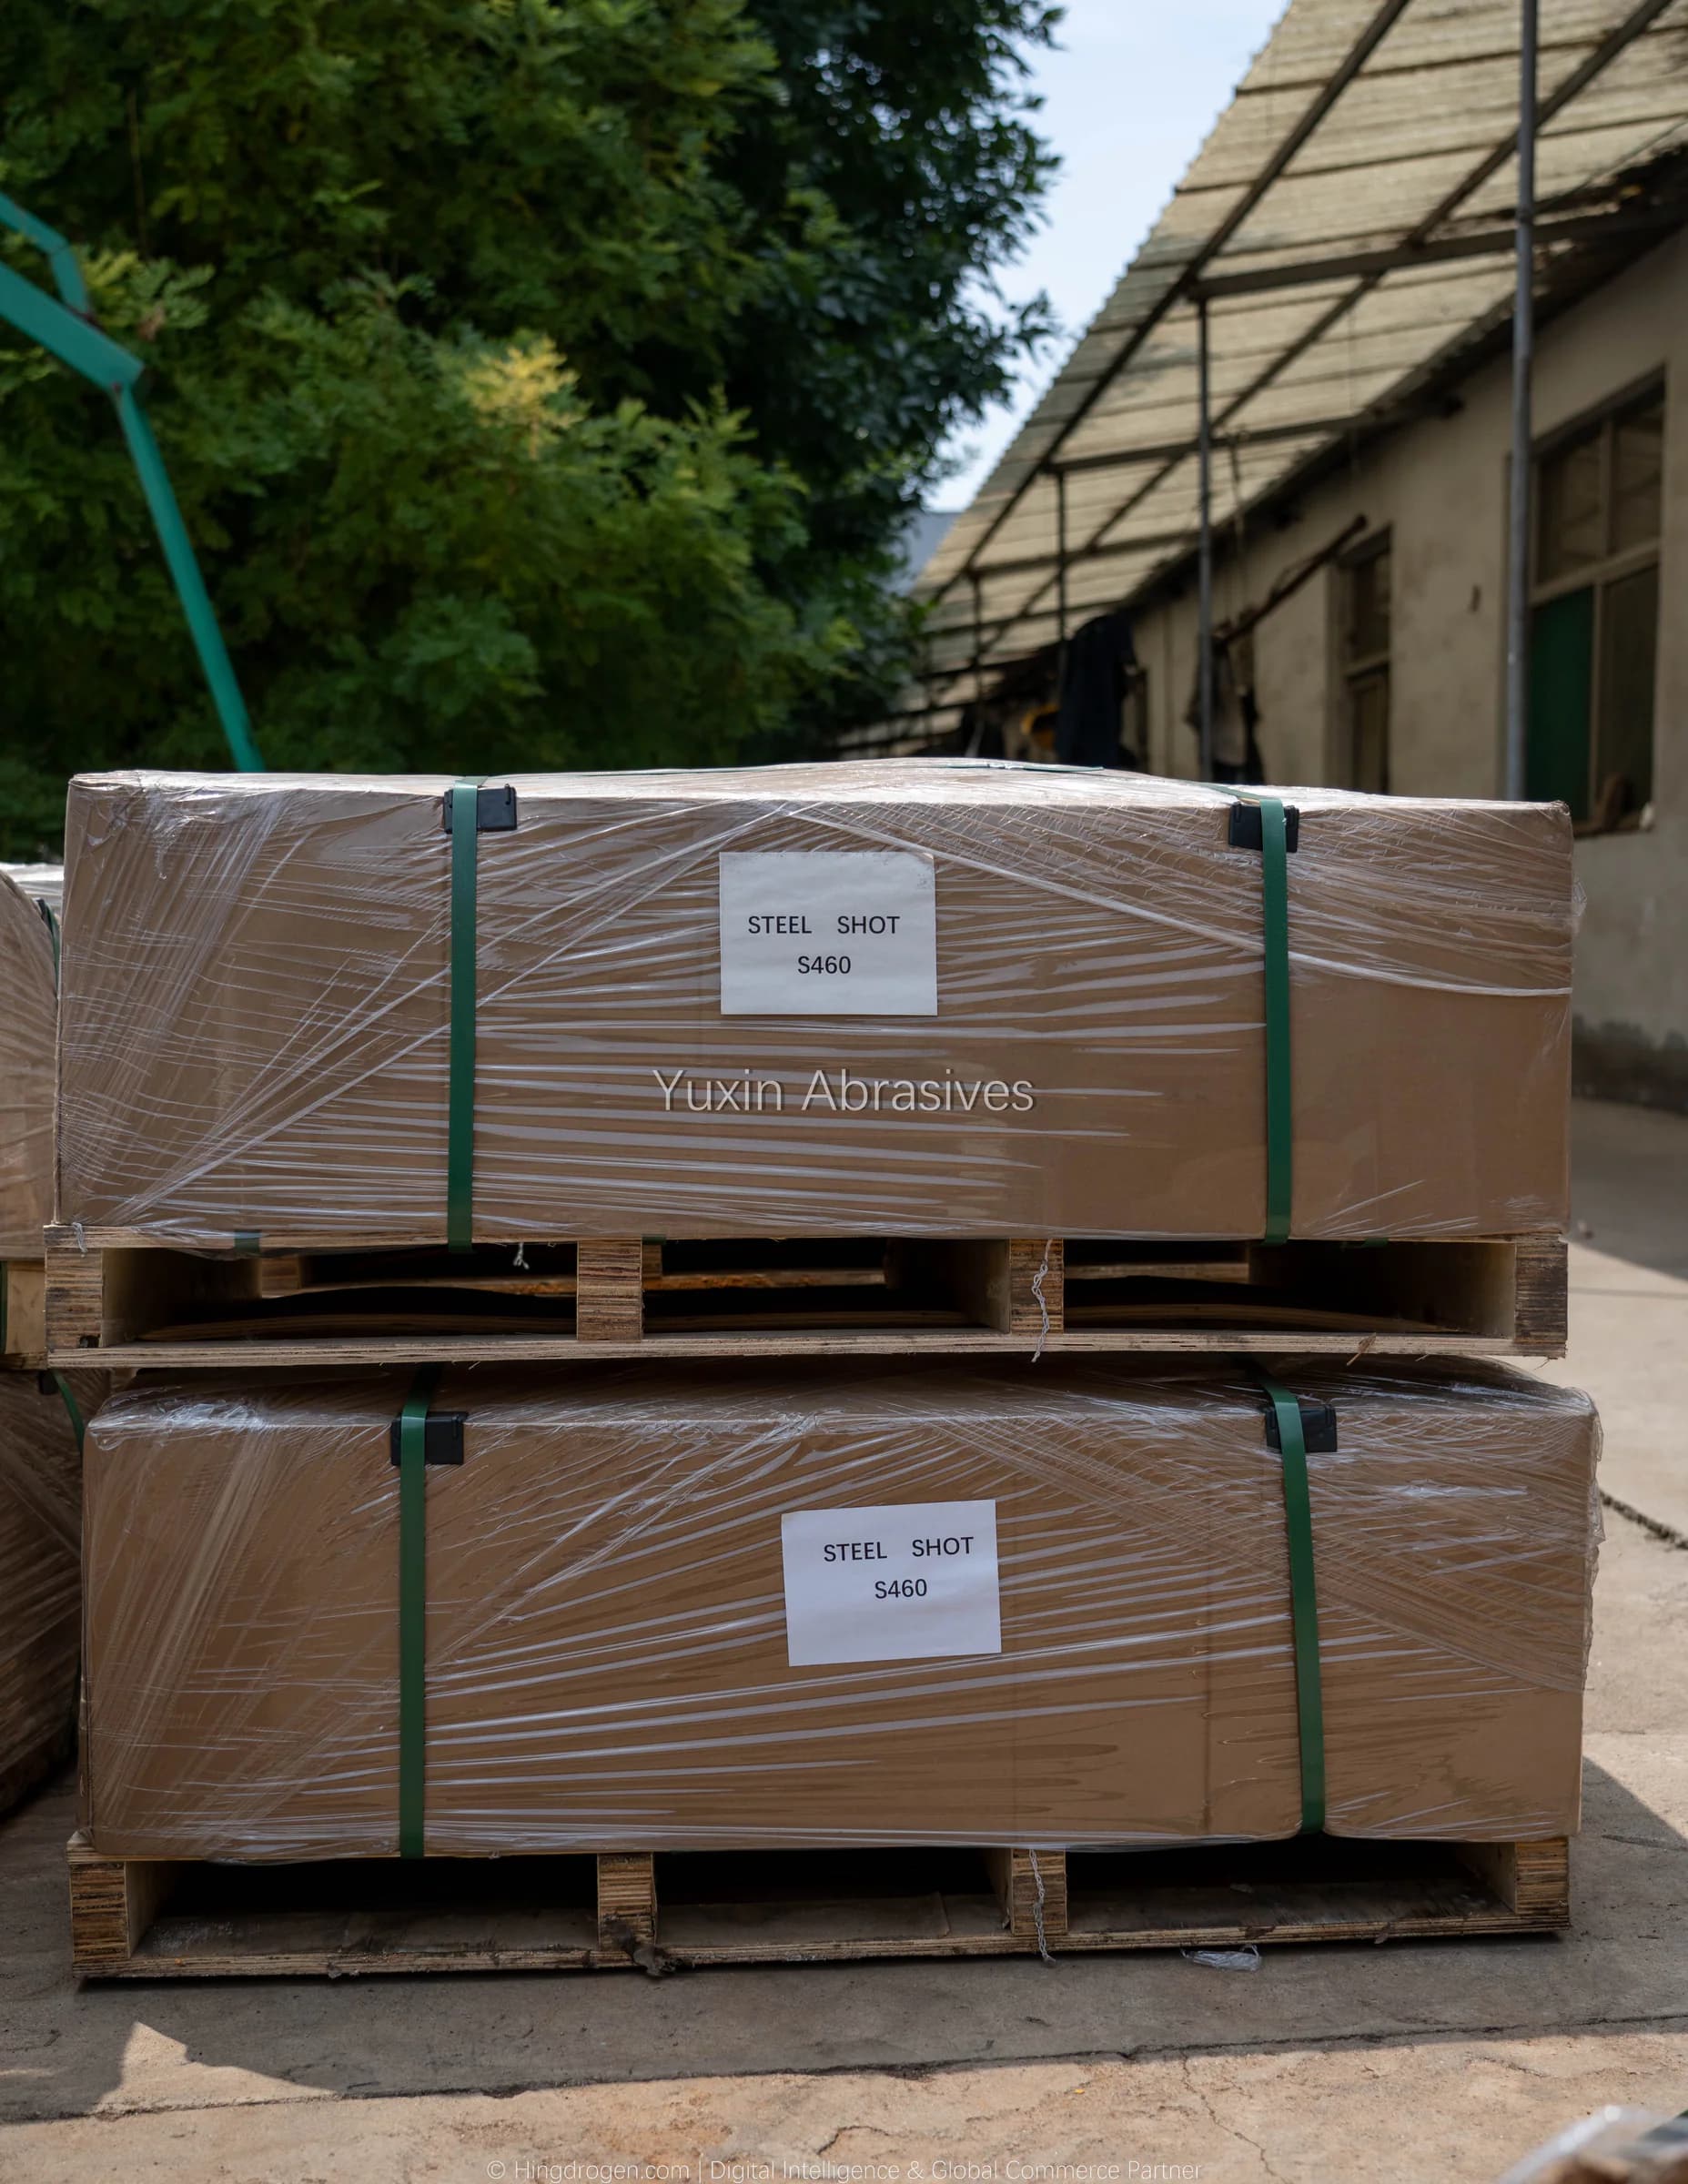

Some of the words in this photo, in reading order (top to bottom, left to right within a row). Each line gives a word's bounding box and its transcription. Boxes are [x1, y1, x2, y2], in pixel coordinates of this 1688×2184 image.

[747, 915, 813, 935] STEEL
[836, 915, 901, 935] SHOT
[797, 956, 852, 976] S460
[823, 1541, 888, 1562] STEEL
[911, 1536, 975, 1557] SHOT
[874, 1578, 927, 1600] S460
